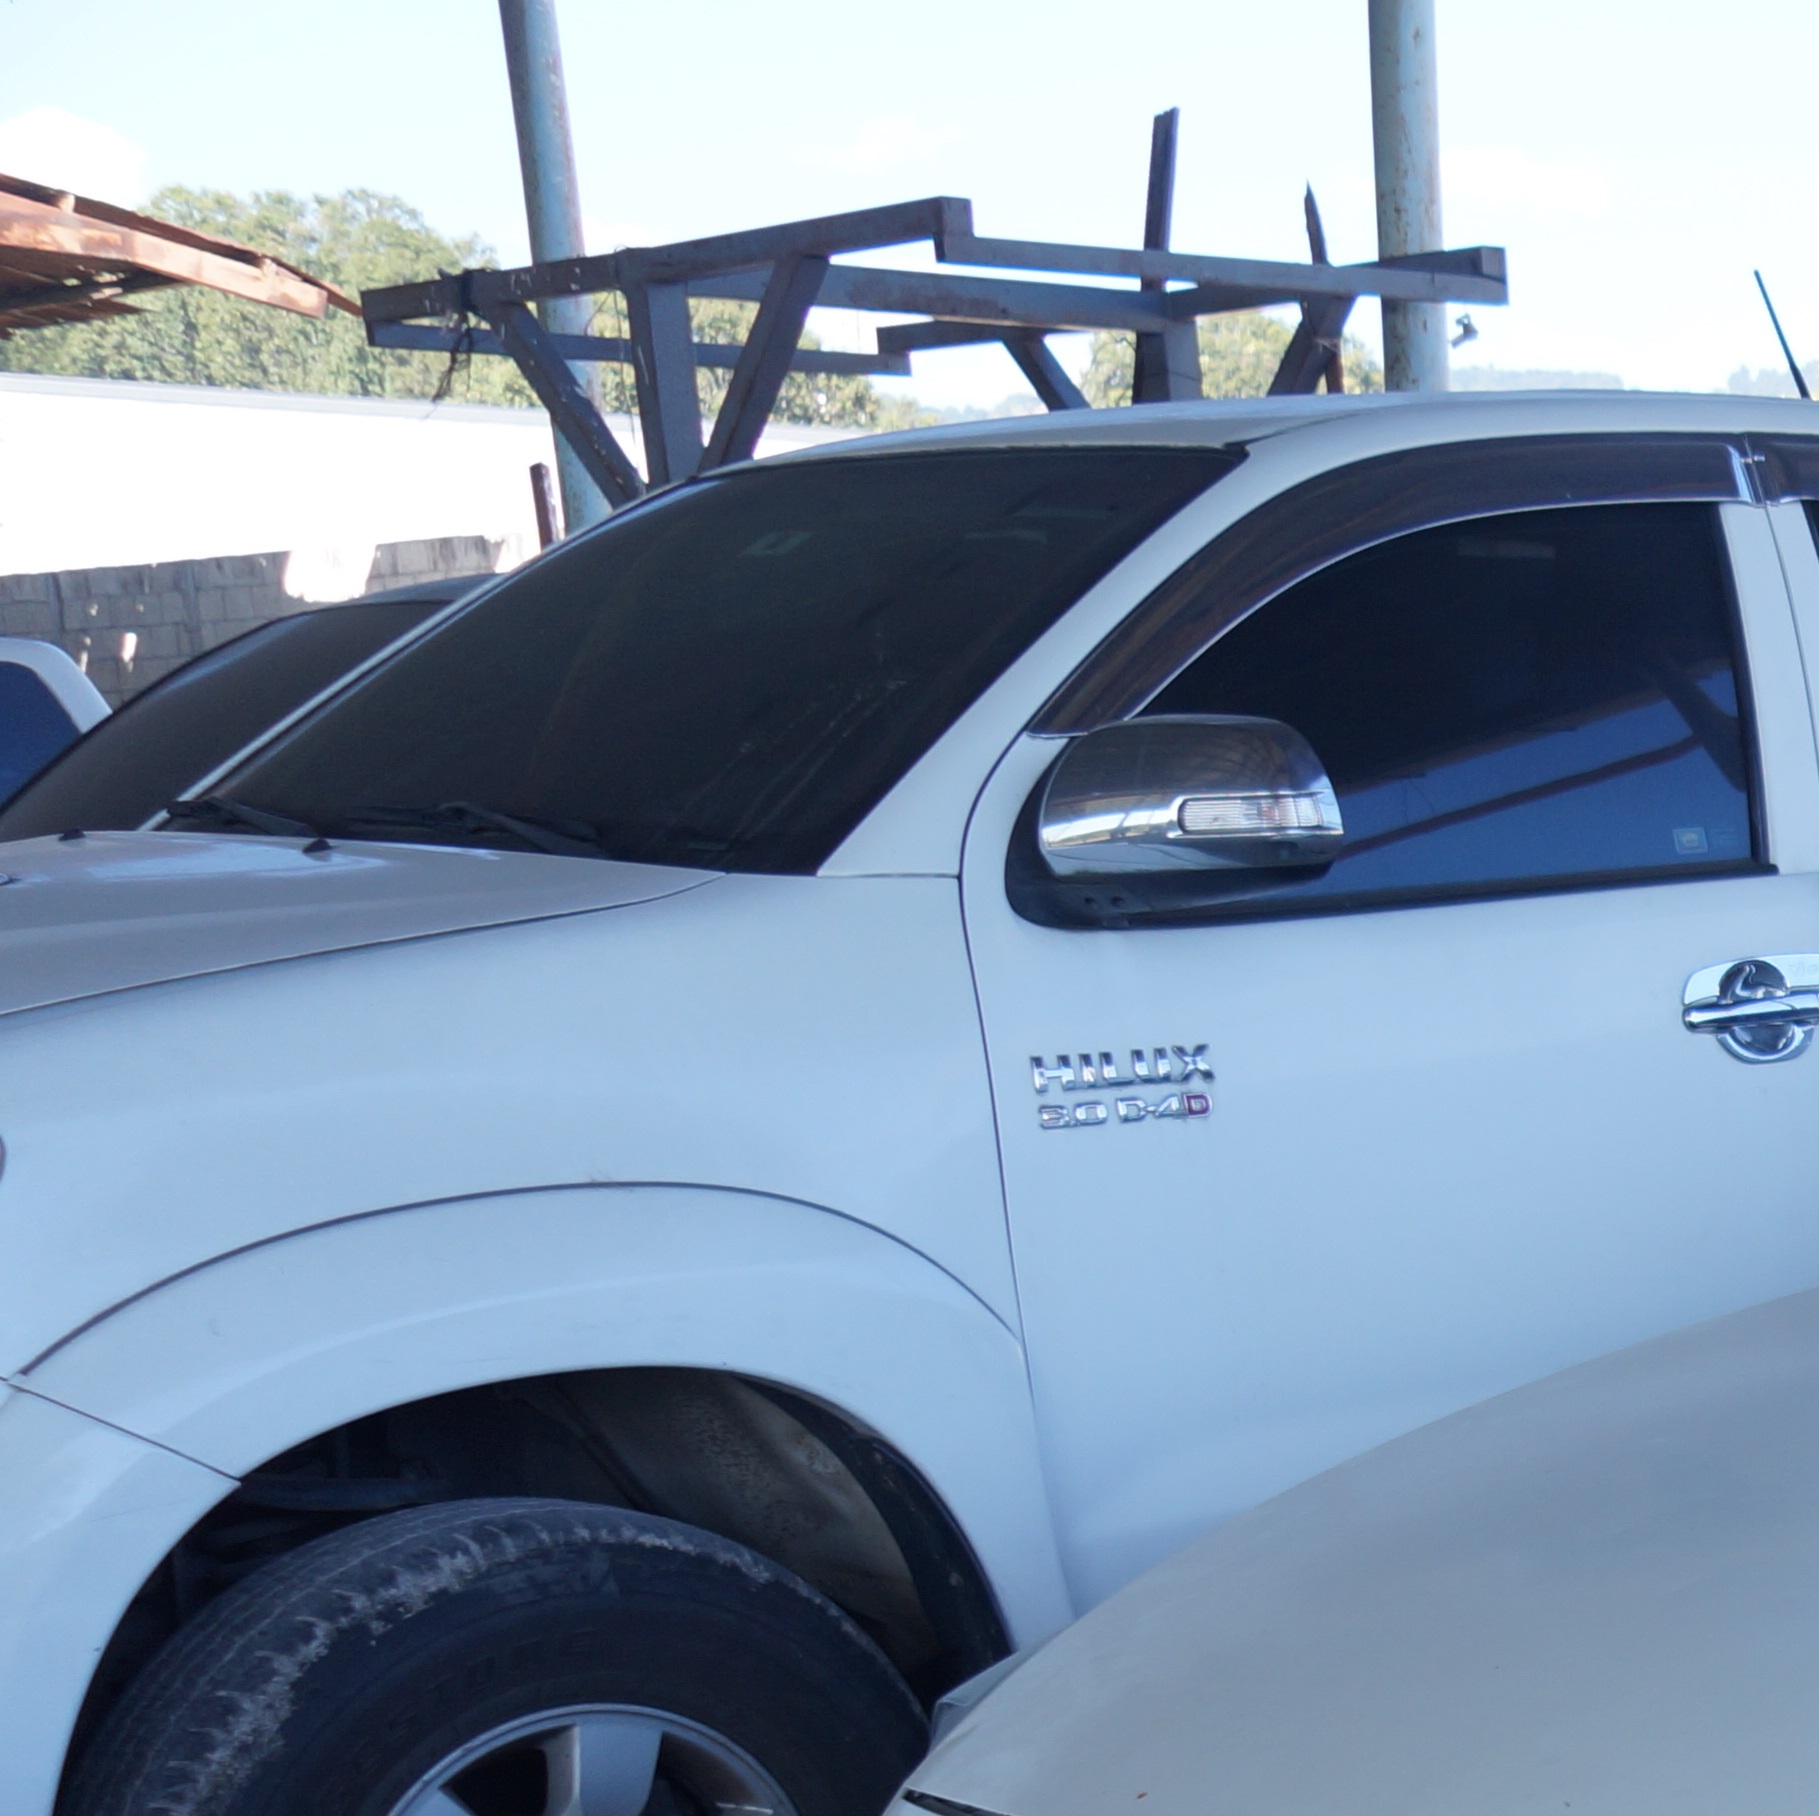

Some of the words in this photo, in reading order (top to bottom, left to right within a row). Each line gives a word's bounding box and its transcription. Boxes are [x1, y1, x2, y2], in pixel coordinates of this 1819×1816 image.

[1029, 1043, 1217, 1094] HILUX
[1038, 1101, 1108, 1130] 3.0
[1116, 1091, 1214, 1125] D-4D
